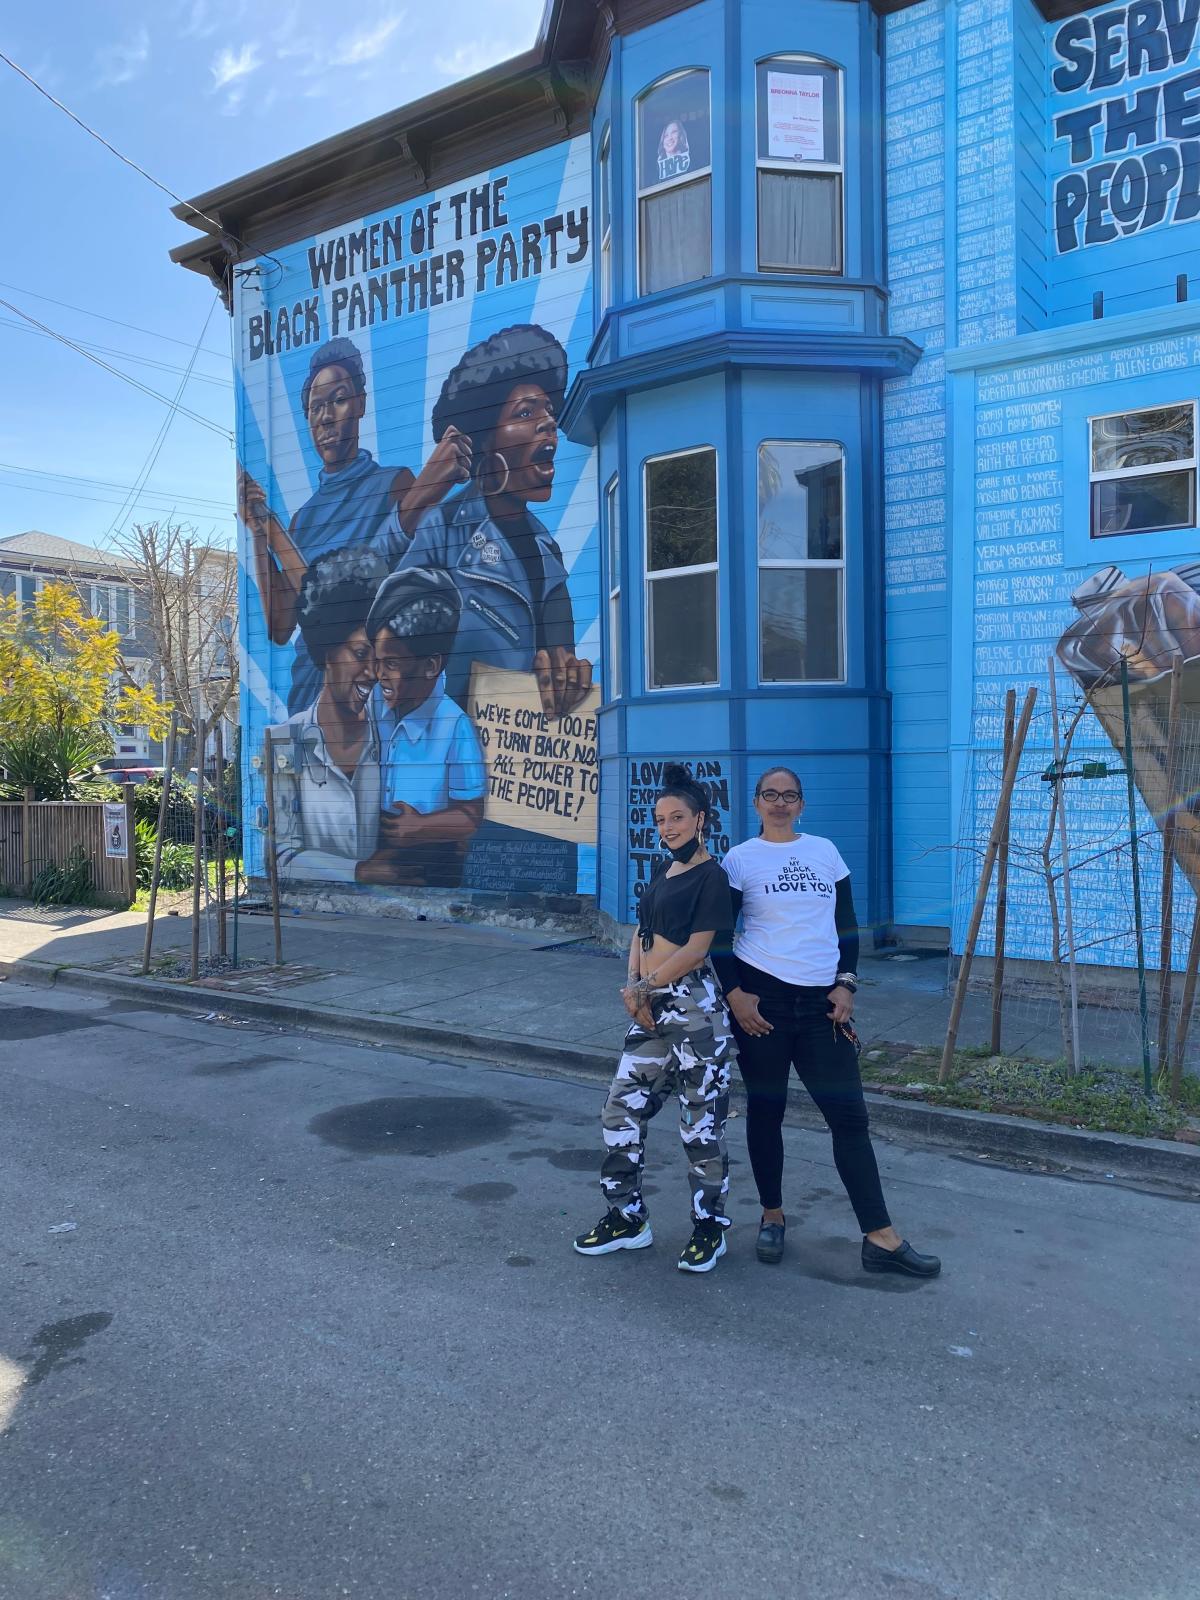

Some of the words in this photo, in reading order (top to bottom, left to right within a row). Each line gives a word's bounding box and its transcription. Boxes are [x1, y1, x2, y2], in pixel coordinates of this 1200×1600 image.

[1052, 0, 1200, 92] SERV
[771, 88, 797, 96] BREONNA
[799, 90, 820, 98] TAYLOR
[1053, 69, 1200, 166] THE
[307, 213, 402, 289] WOMEN
[410, 201, 441, 254] OF
[450, 176, 508, 240] THE
[250, 297, 320, 361] BLACK
[331, 249, 464, 336] PANTHER
[476, 206, 588, 292] PARTY
[1115, 358, 1146, 379] ALLEN
[1021, 435, 1055, 452] BEARD
[978, 456, 1002, 472] RUTH
[1021, 481, 1063, 500] BENNETT
[1015, 517, 1057, 536] BOWMAN
[1017, 539, 1058, 554] BREWER
[978, 558, 1004, 573] LINDA
[1008, 553, 1064, 569] BRICKHOUSE
[976, 591, 1009, 606] ELAINE
[1014, 587, 1049, 603] BROWN
[976, 612, 1009, 625] MARION
[1013, 609, 1047, 623] BROWN
[476, 701, 511, 726] WE'VE
[515, 709, 549, 733] COME
[558, 712, 582, 737] TOO
[475, 725, 490, 747] TO
[495, 728, 531, 753] TURN
[534, 735, 570, 760] BACK
[494, 753, 516, 777] ALL
[523, 757, 574, 788] POWER
[580, 768, 599, 795] TO
[696, 761, 721, 778] AN
[489, 775, 514, 803] THE
[517, 782, 584, 822] PEOPLE!
[631, 807, 647, 825] OF
[630, 828, 655, 850] WE
[713, 834, 730, 853] TO
[778, 872, 821, 882] PEOPLE,
[783, 866, 811, 874] BLACK
[764, 884, 770, 895] I
[772, 882, 808, 893] LOVE
[809, 882, 833, 894] YOU
